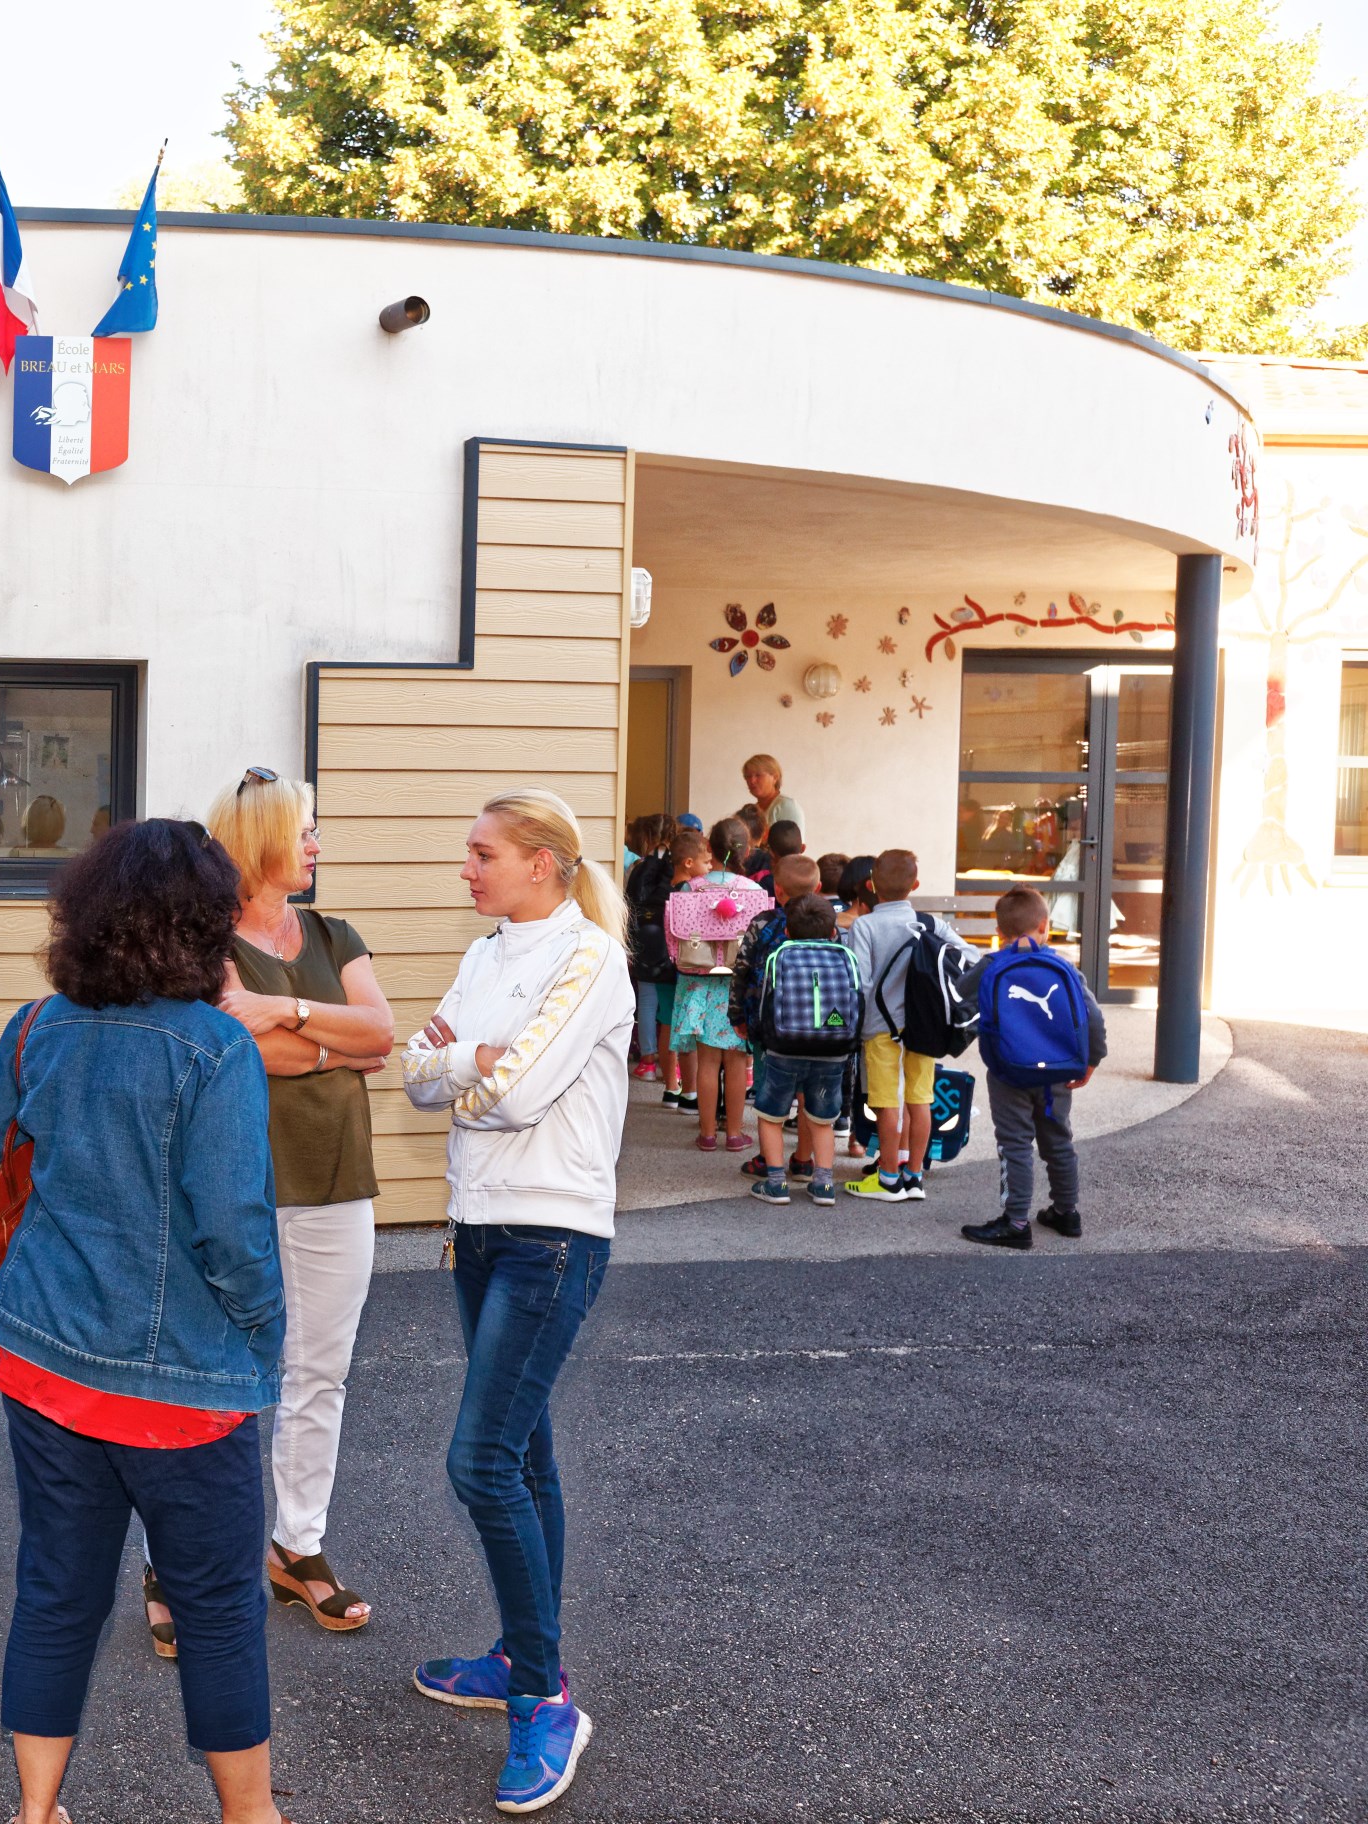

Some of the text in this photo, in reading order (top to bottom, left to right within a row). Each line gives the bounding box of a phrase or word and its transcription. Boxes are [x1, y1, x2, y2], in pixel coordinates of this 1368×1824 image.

[57, 340, 90, 355] École
[21, 360, 125, 375] BREAU et MARS
[58, 435, 84, 443] Liberté
[52, 457, 89, 465] Fraternité
